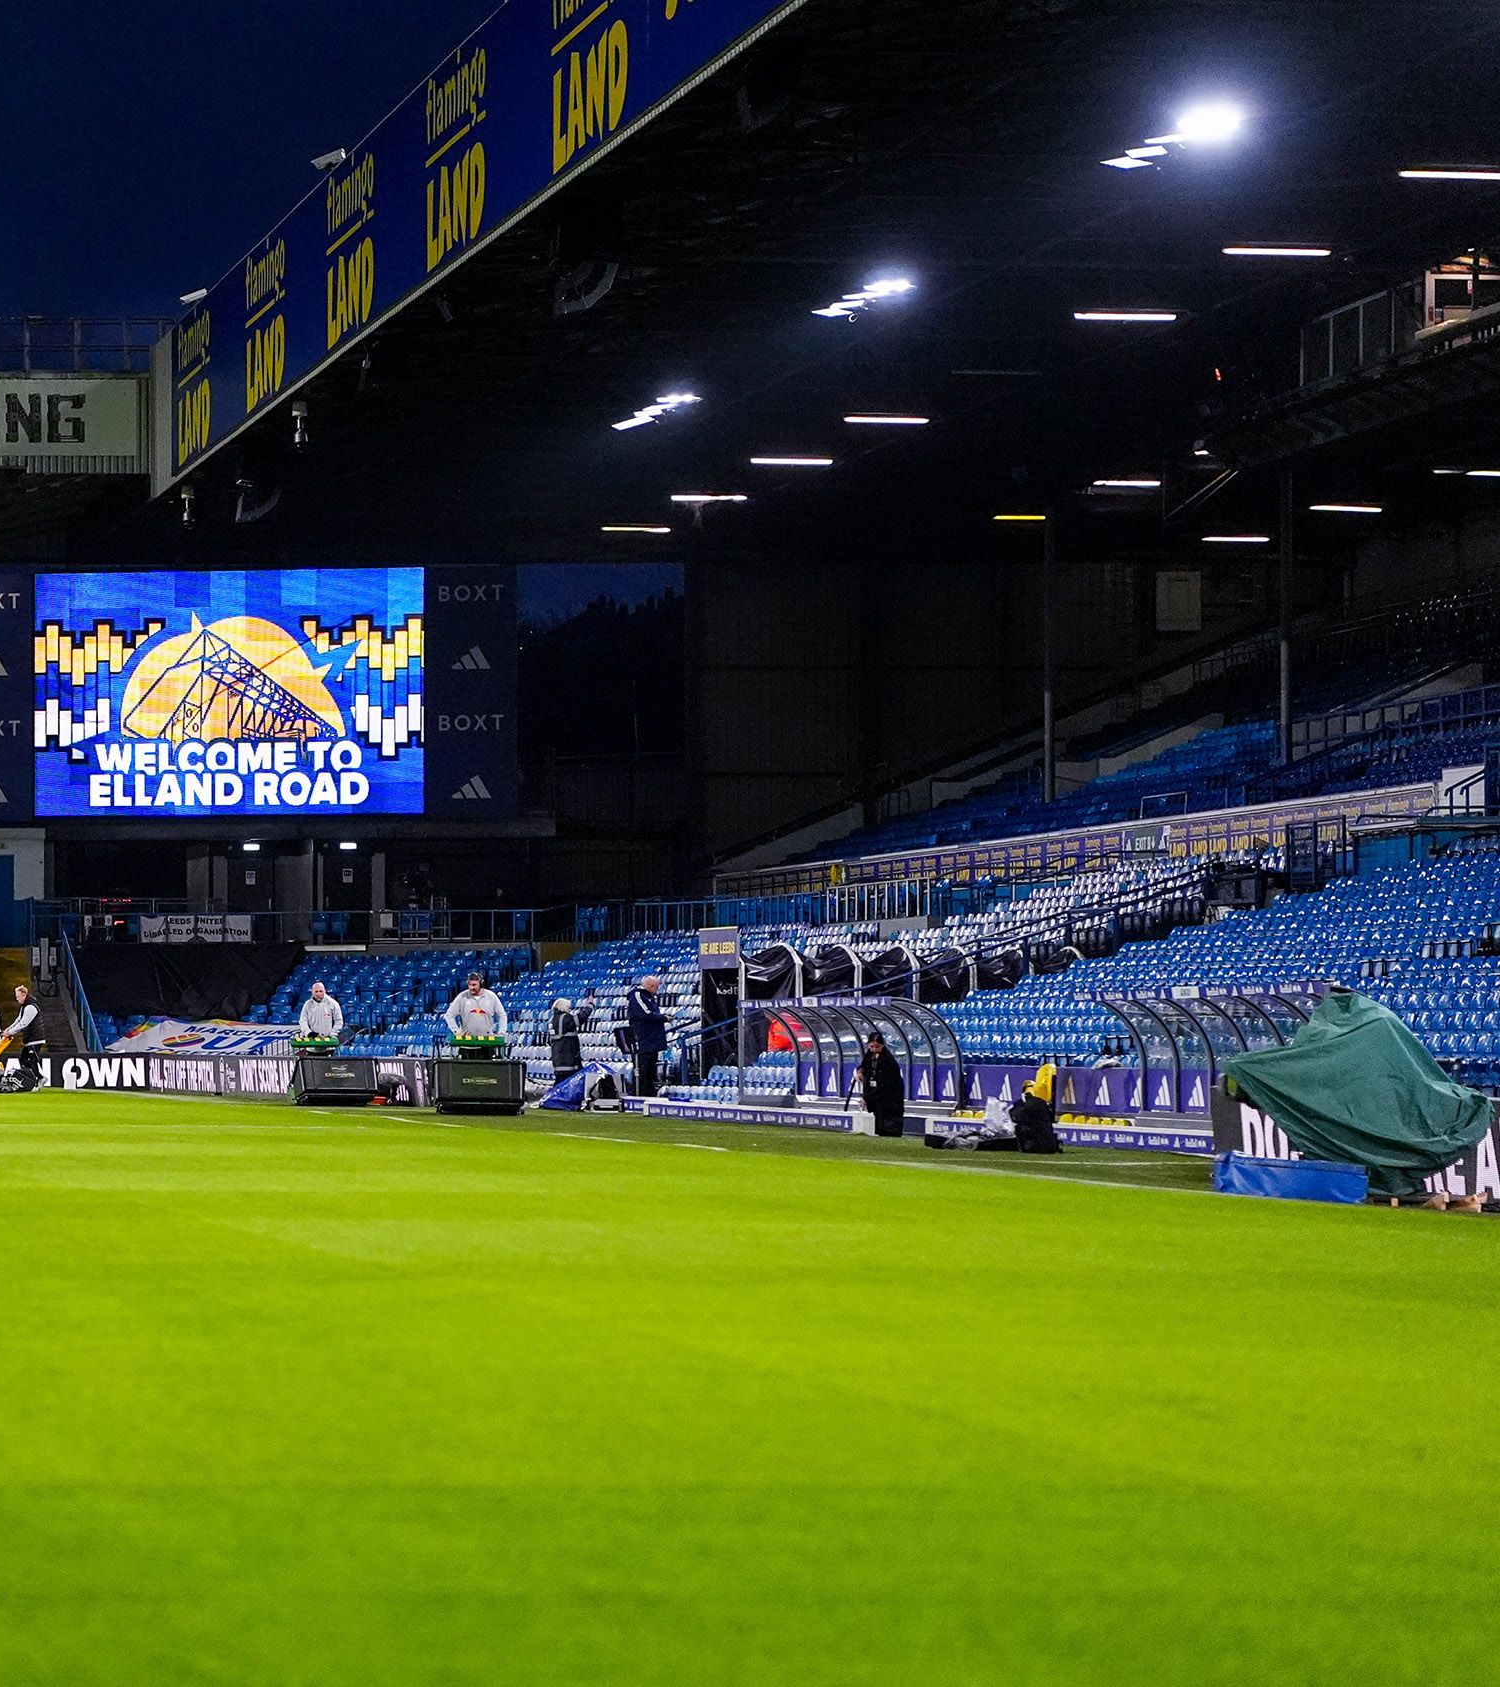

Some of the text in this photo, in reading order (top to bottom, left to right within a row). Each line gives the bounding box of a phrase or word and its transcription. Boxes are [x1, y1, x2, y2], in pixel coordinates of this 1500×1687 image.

[426, 47, 486, 145] flamingo
[553, 19, 628, 175] LAND
[326, 152, 374, 236] flamingo
[426, 142, 485, 272] LAND
[245, 238, 286, 310] flamingo
[327, 237, 374, 350] LAND
[178, 309, 211, 372] flamingo
[246, 314, 285, 414] LAND
[178, 378, 211, 467] LAND
[438, 584, 504, 602] BOXT
[438, 714, 505, 732] BOXT
[89, 772, 370, 807] ELLAND ROAD
[97, 740, 362, 775] WELCOME TO
[1170, 842, 1187, 858] LAND
[1190, 840, 1207, 856] LAND
[719, 941, 735, 955] LEEDS
